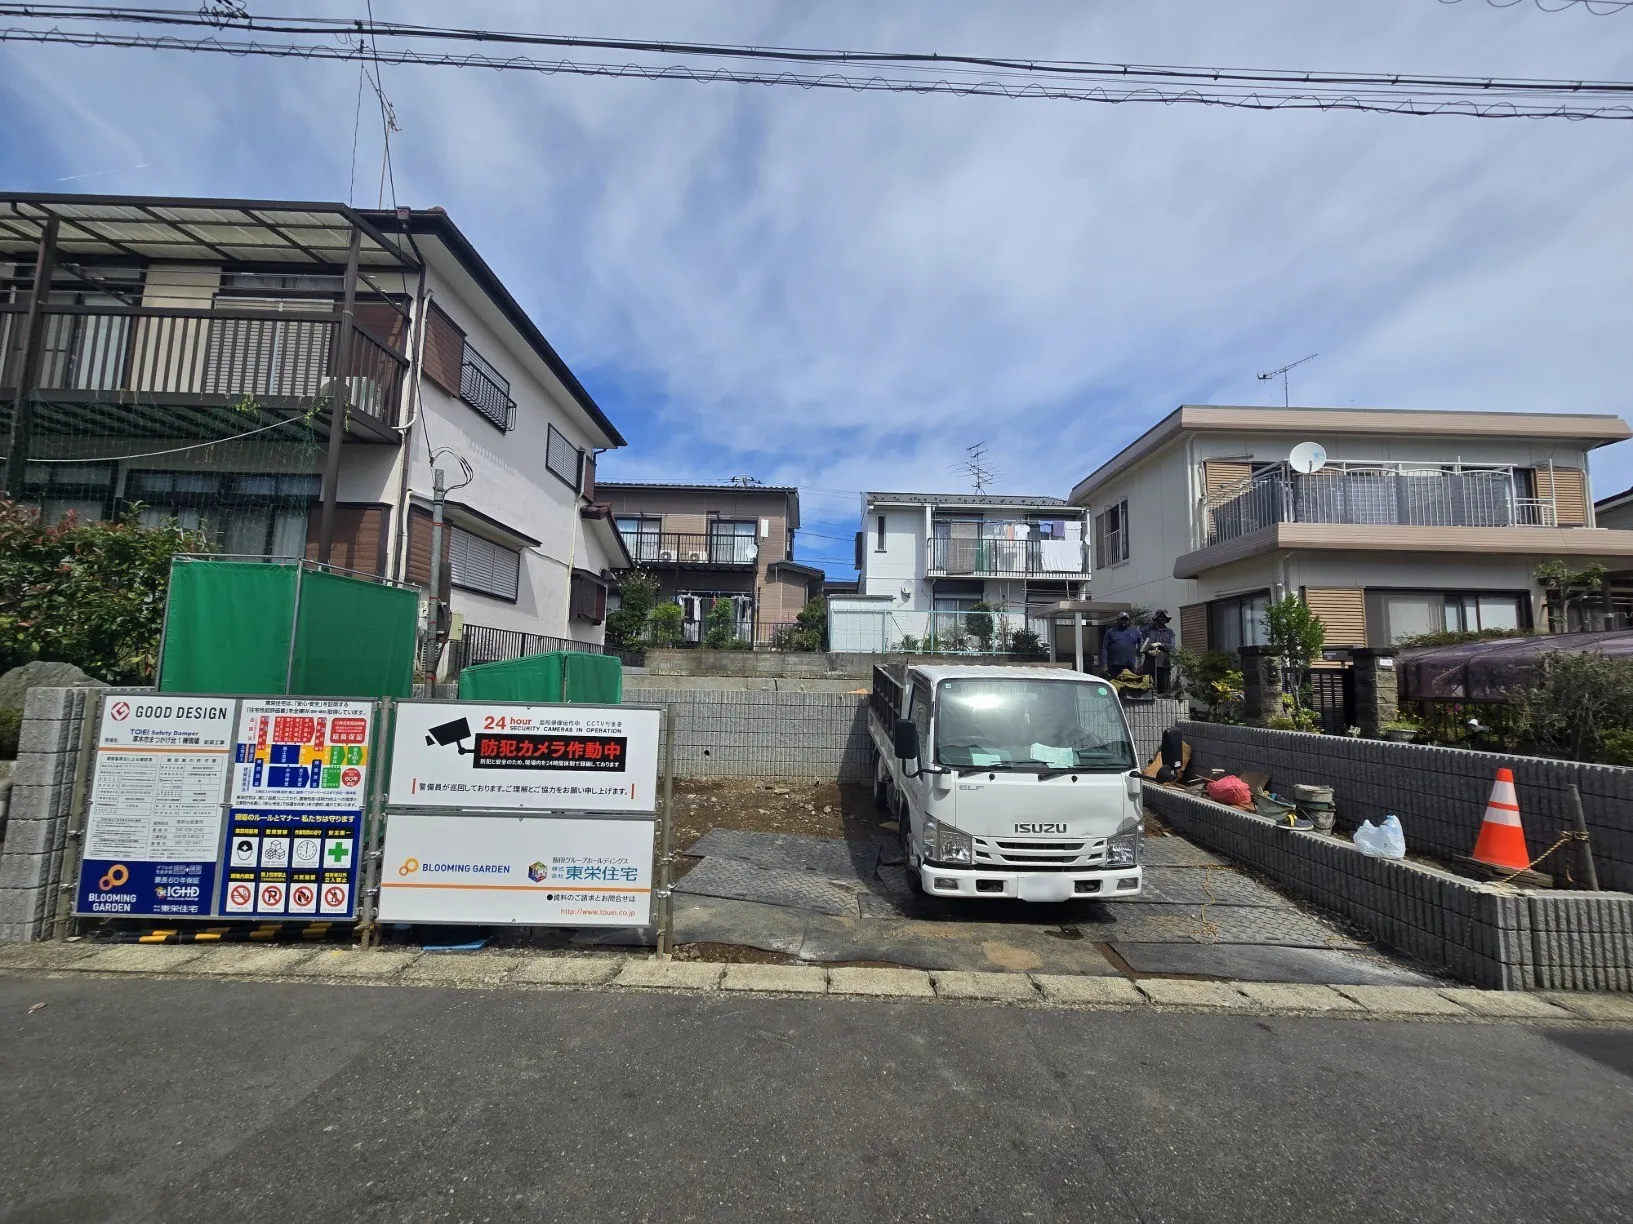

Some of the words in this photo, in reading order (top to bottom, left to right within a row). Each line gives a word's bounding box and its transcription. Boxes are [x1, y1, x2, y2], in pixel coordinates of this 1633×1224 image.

[136, 705, 172, 719] GOOD
[176, 706, 227, 720] DESIGN
[484, 716, 506, 730] 24
[510, 716, 532, 726] hour
[480, 739, 621, 759] 防犯カメラ作動中
[419, 782, 628, 796] 警備員が巡回しております。ご理解とご協力をお願い申し上げます。
[234, 814, 300, 822] 現場のルールとマナー
[302, 815, 355, 823] 私たちは守ります
[1014, 823, 1067, 834] ISUZU
[552, 856, 628, 864] 飯田グループホールディングス
[422, 863, 470, 873] BLOOMING
[472, 864, 510, 874] GARDEN
[566, 866, 638, 882] 東栄住宅
[88, 893, 136, 903] BLOOMING
[92, 903, 130, 912] GARDEN
[560, 908, 636, 916] http://www.touei.co.jp
